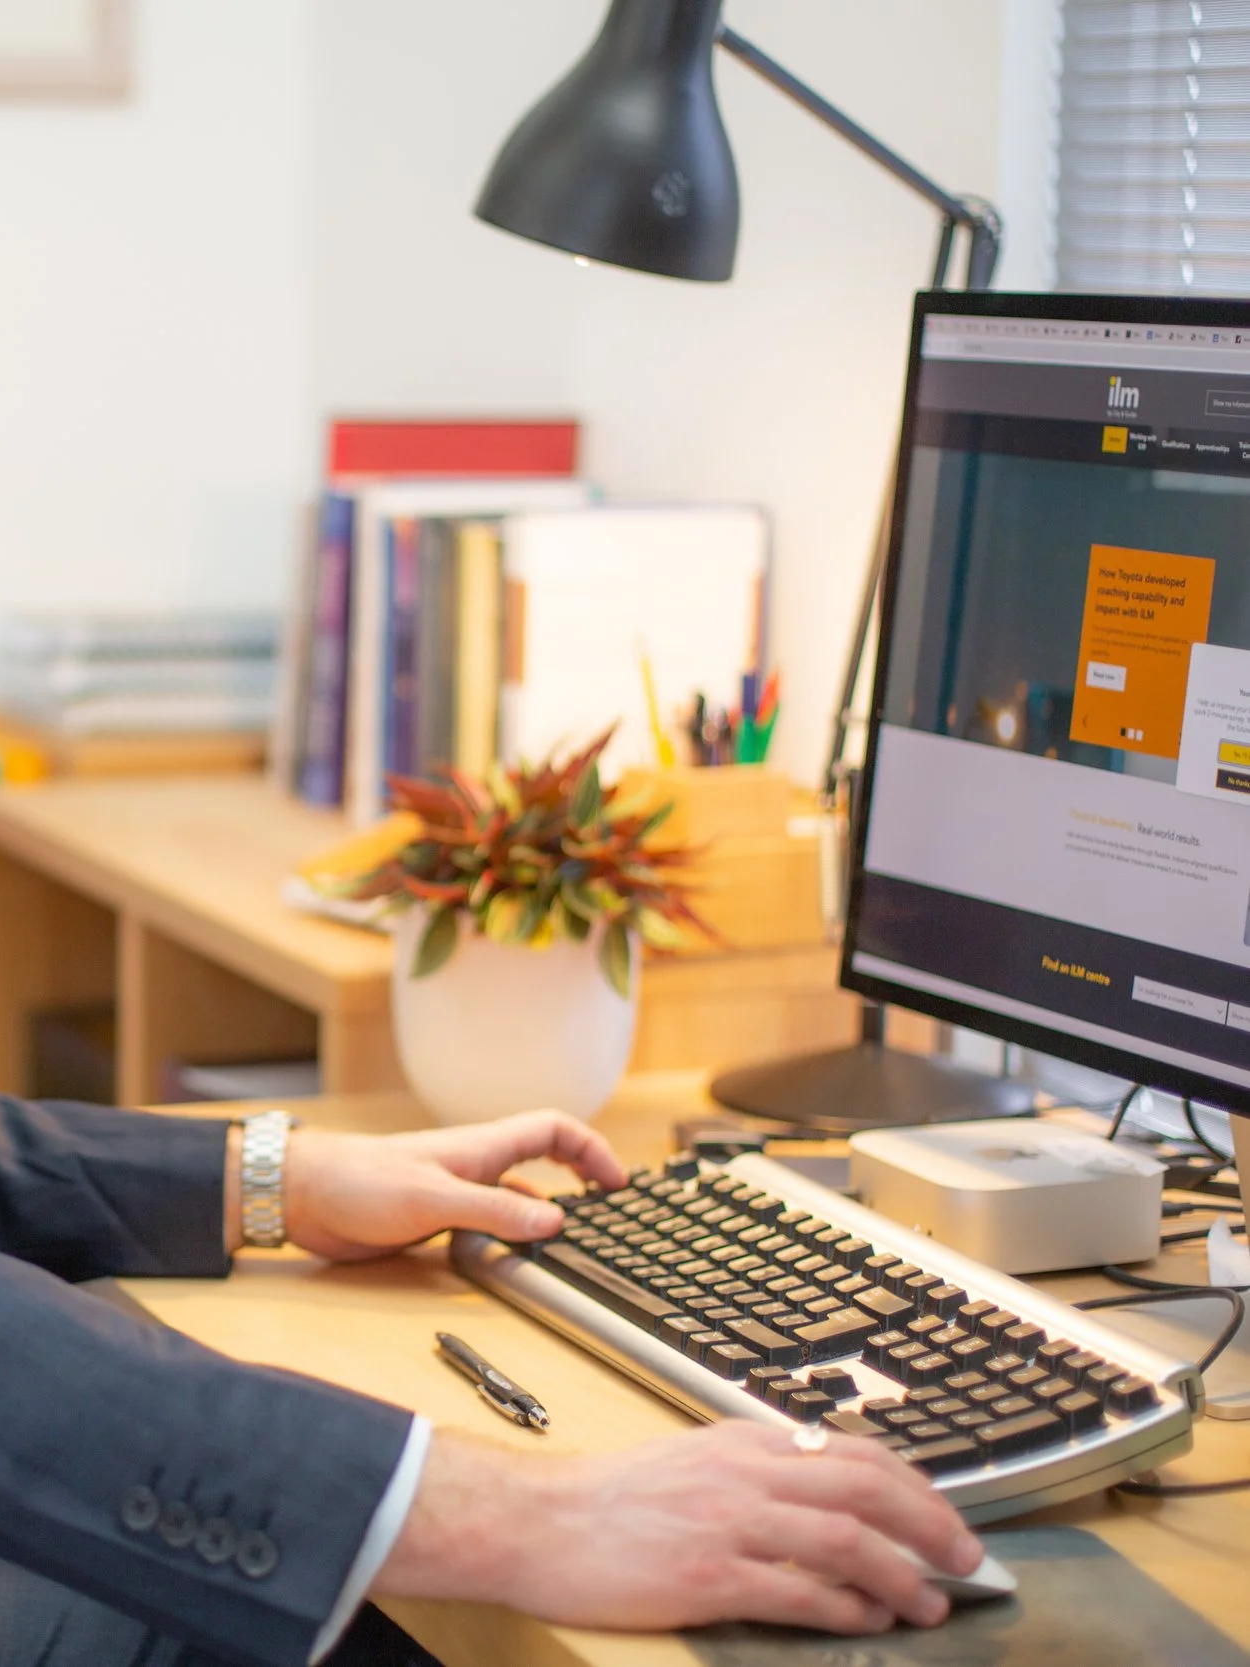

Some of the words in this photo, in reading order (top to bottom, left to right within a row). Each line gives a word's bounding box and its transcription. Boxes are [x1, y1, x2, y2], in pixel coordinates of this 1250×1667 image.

[1108, 375, 1139, 409] ilm
[1098, 568, 1116, 578] How
[1118, 569, 1143, 583] Toyota
[1144, 576, 1186, 589] developed
[1097, 587, 1129, 600] coaching
[1132, 592, 1168, 607] capability
[1169, 596, 1185, 606] and
[1095, 603, 1120, 616] impact
[1122, 607, 1138, 618] with
[1042, 954, 1059, 973] Find
[1085, 970, 1111, 987] centre
